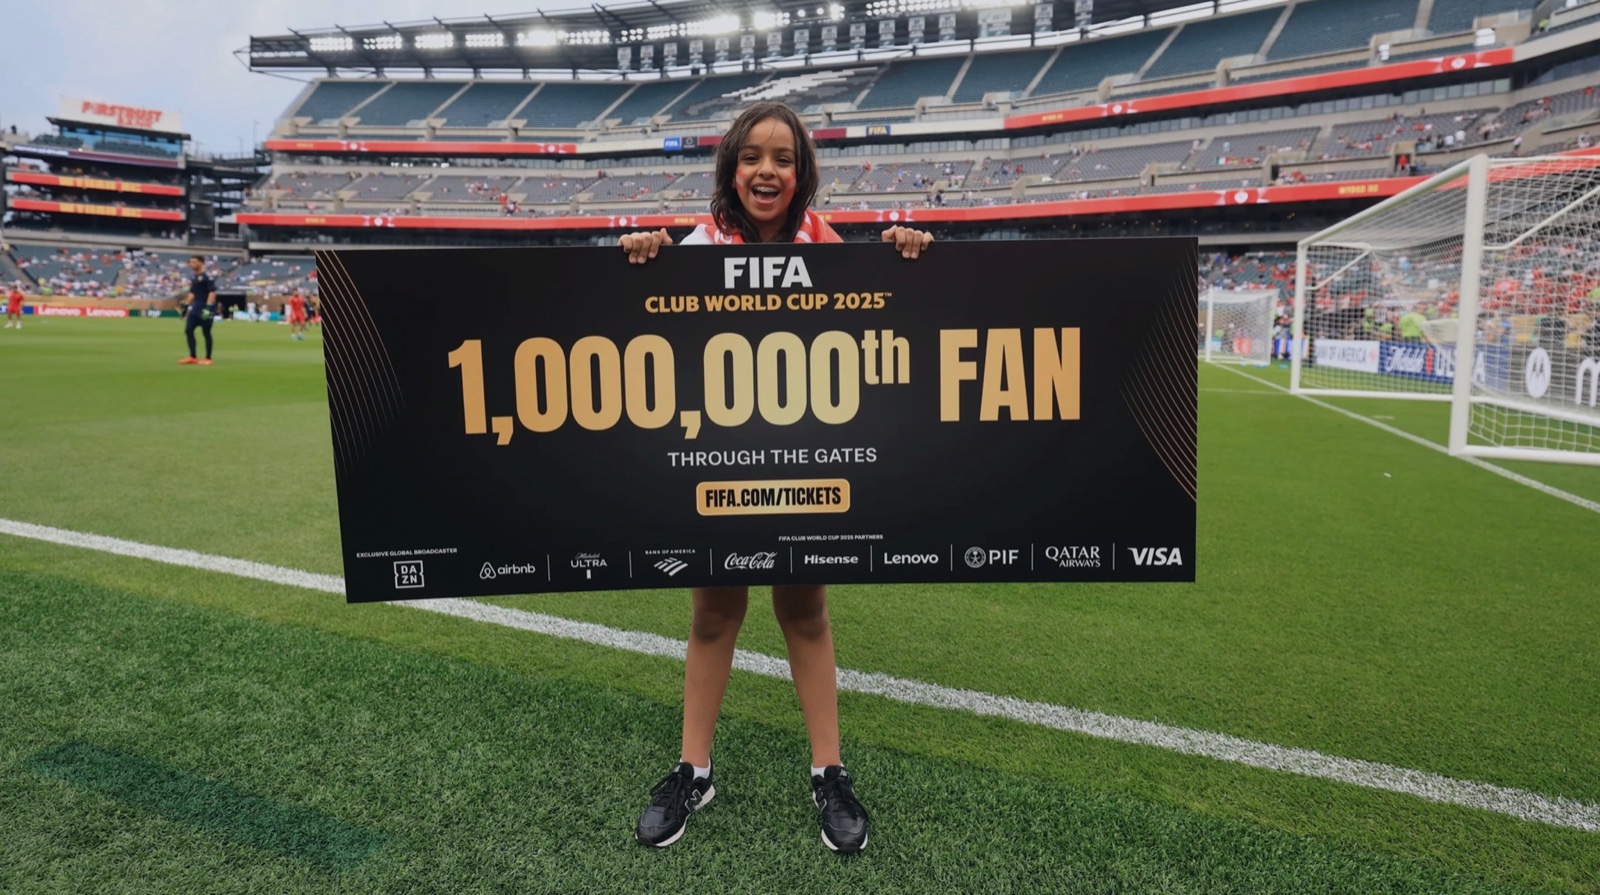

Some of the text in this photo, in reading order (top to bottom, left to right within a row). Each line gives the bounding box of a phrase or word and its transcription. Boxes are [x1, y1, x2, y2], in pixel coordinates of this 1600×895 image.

[724, 256, 813, 289] FIFA
[645, 296, 700, 313] CLUB
[704, 294, 782, 312] WORLD
[786, 293, 828, 310] CUP
[37, 306, 81, 317] Lenovo
[86, 307, 126, 318] Lenovo
[448, 327, 1081, 446] 1,000,000th FAN
[667, 447, 877, 467] THROUGH THE GATES
[705, 486, 841, 508] FIFA.COM/TICKETS
[804, 554, 859, 564] Hisense
[884, 552, 939, 564] Lenovo
[989, 550, 1019, 565] PIF
[1045, 546, 1100, 561] QATAR
[1127, 547, 1183, 566] VISA
[497, 563, 536, 575] airbnb
[570, 559, 607, 568] ULTRA
[1059, 559, 1101, 568] AIRWAYS
